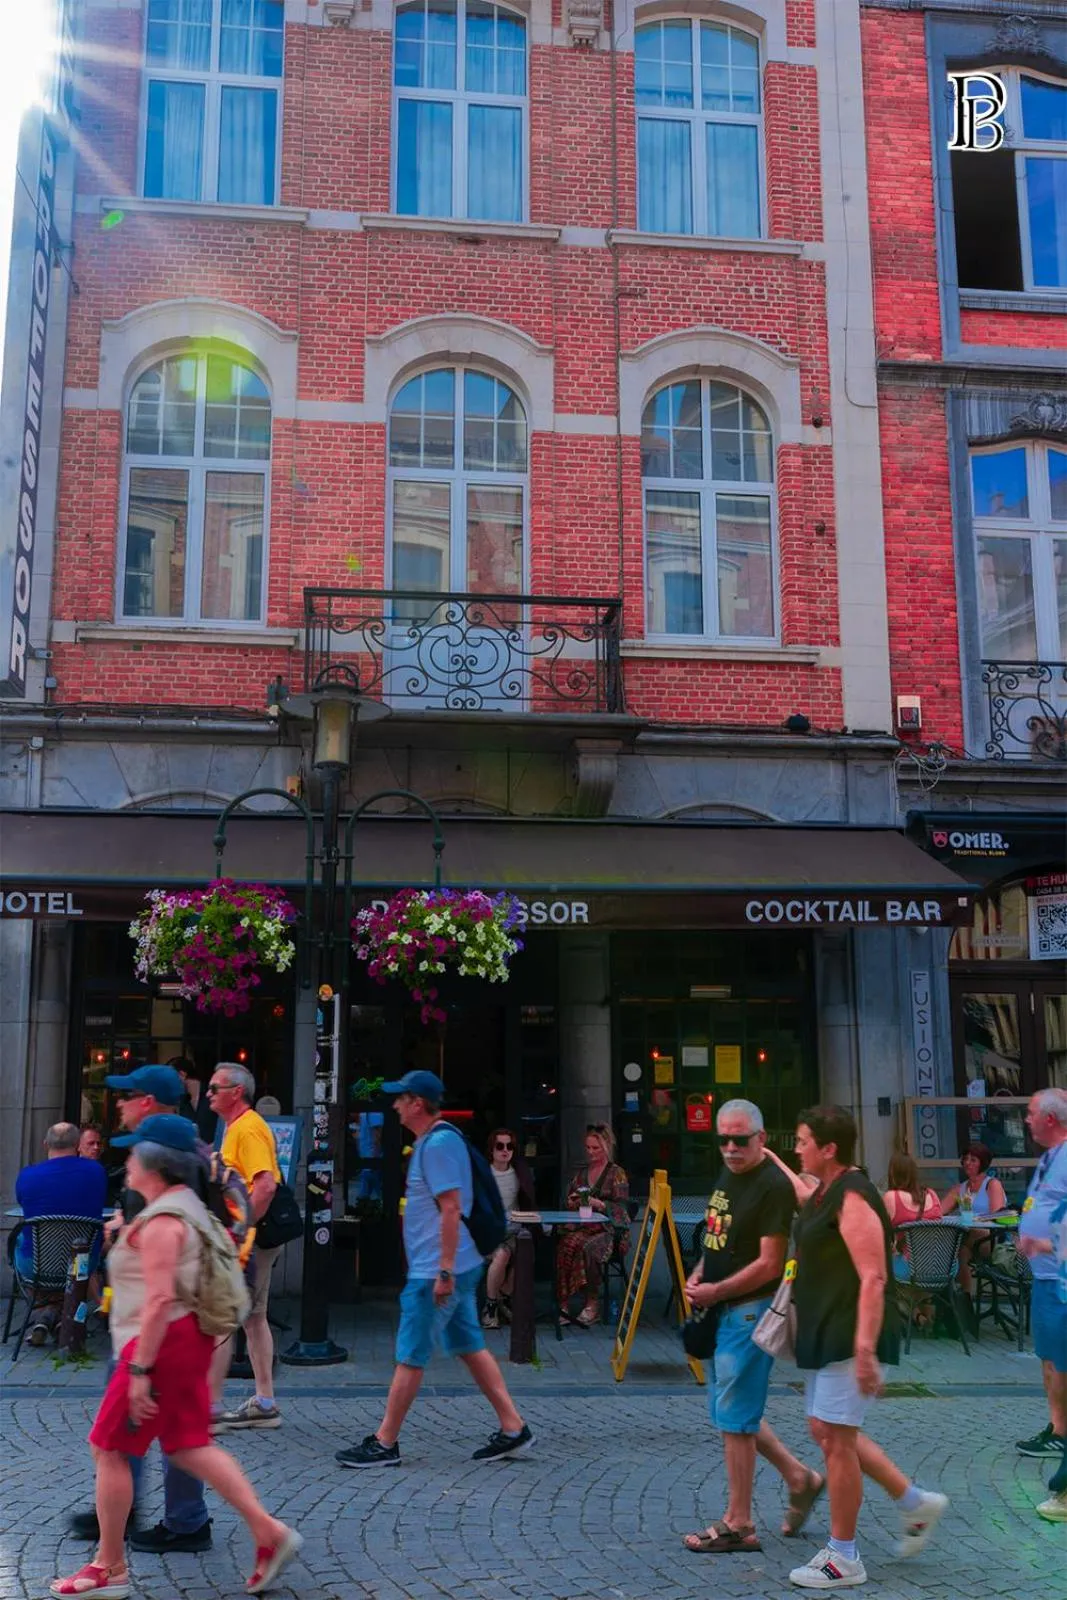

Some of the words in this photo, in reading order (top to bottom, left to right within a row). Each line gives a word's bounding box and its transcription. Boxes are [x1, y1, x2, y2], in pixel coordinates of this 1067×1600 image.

[11, 127, 54, 681] PROFESSOR
[1050, 872, 1067, 886] HU
[516, 901, 589, 924] SSOR
[746, 900, 879, 922] COCKTAIL
[886, 900, 942, 922] BAR
